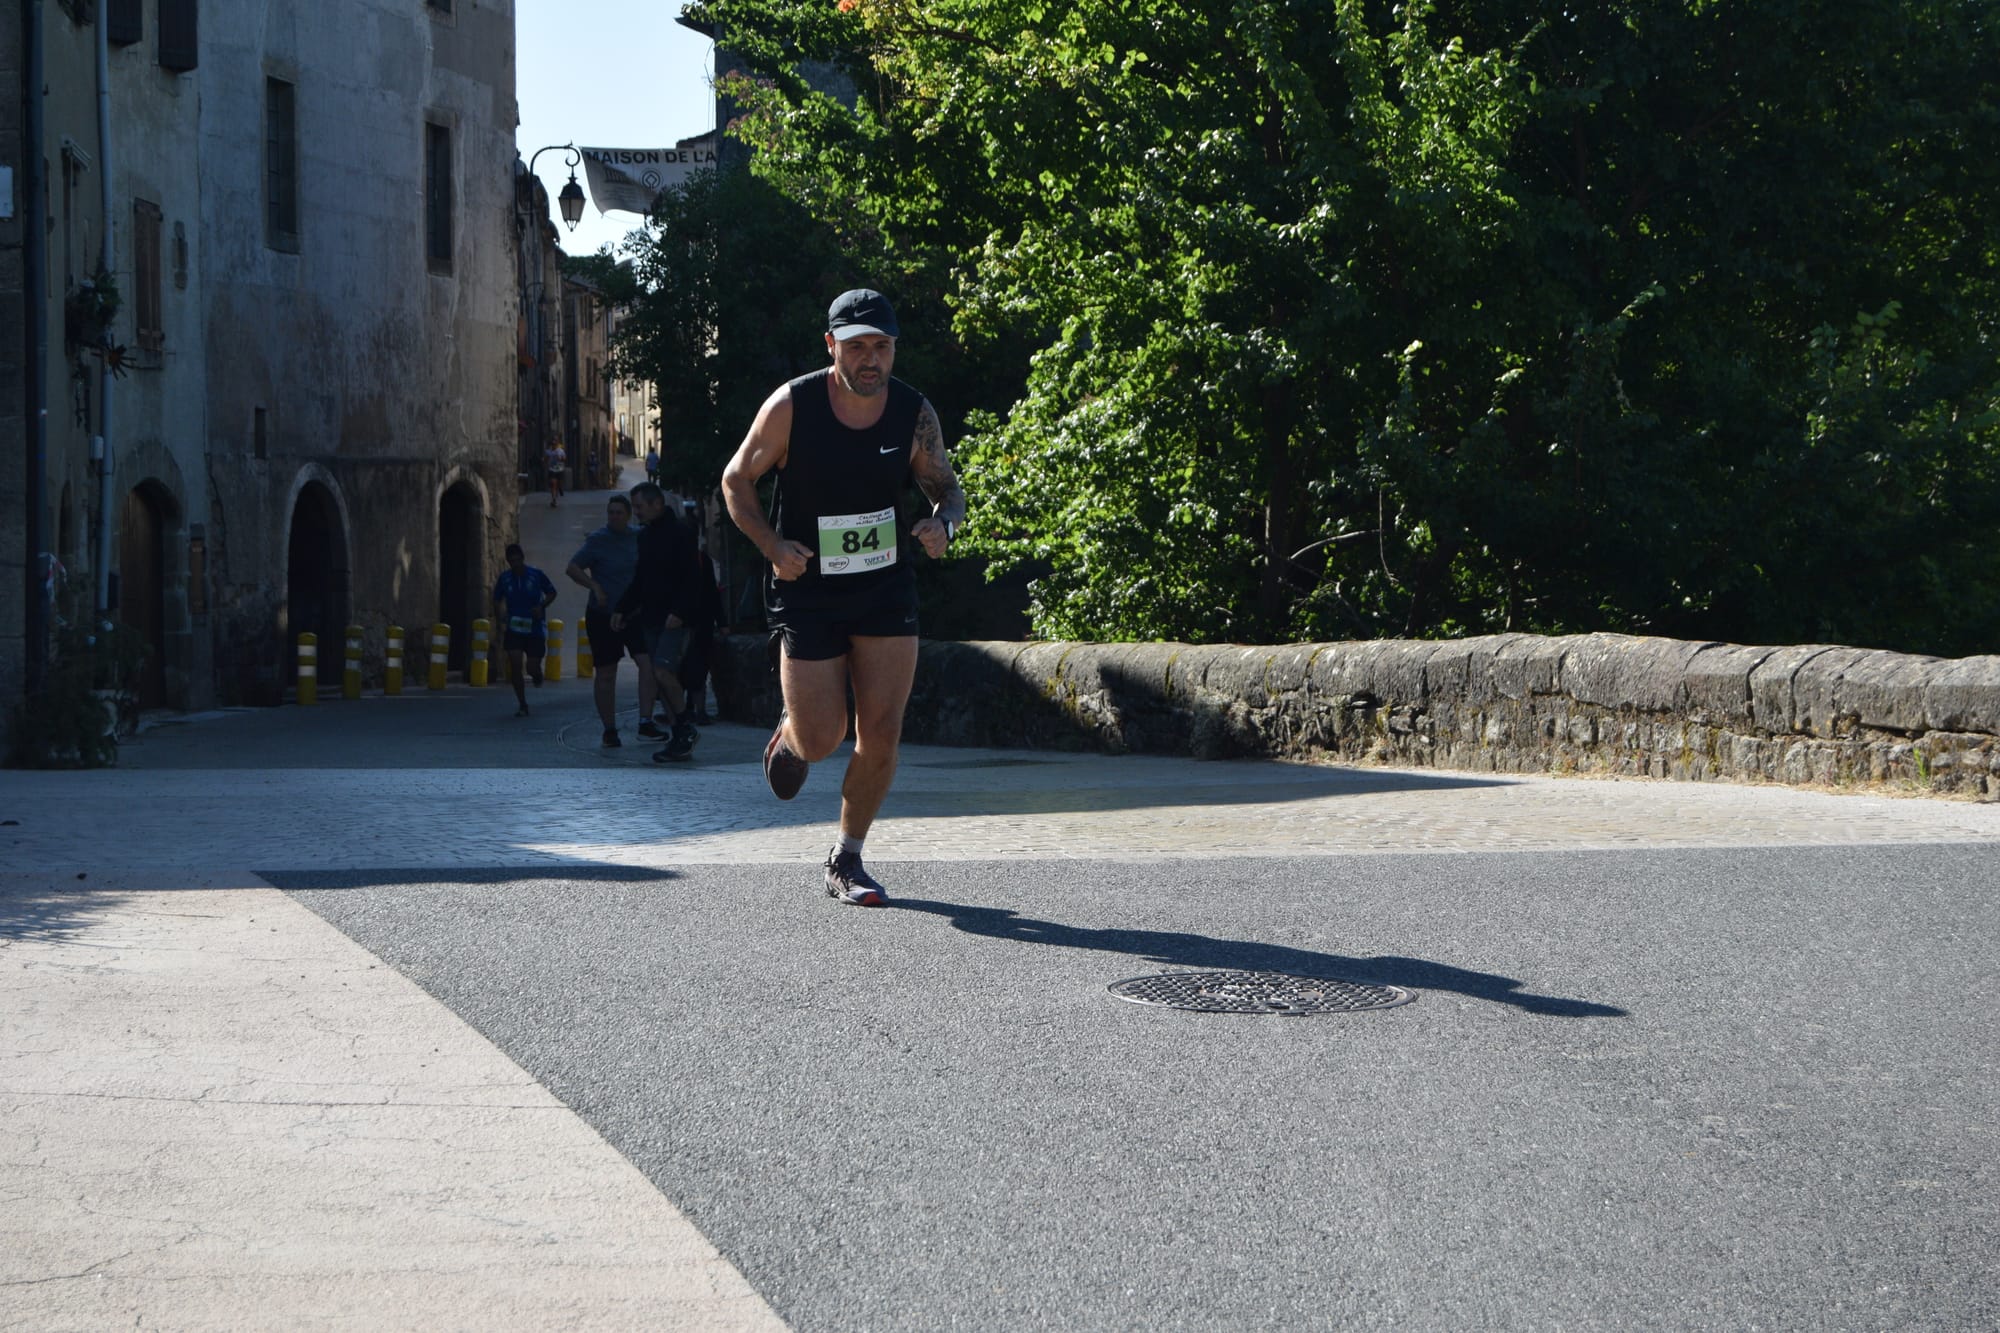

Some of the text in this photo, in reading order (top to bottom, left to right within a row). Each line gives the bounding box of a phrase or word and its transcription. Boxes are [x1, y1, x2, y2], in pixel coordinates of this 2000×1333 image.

[587, 151, 659, 164] MAISON
[665, 151, 689, 163] DE
[842, 528, 880, 553] 84
